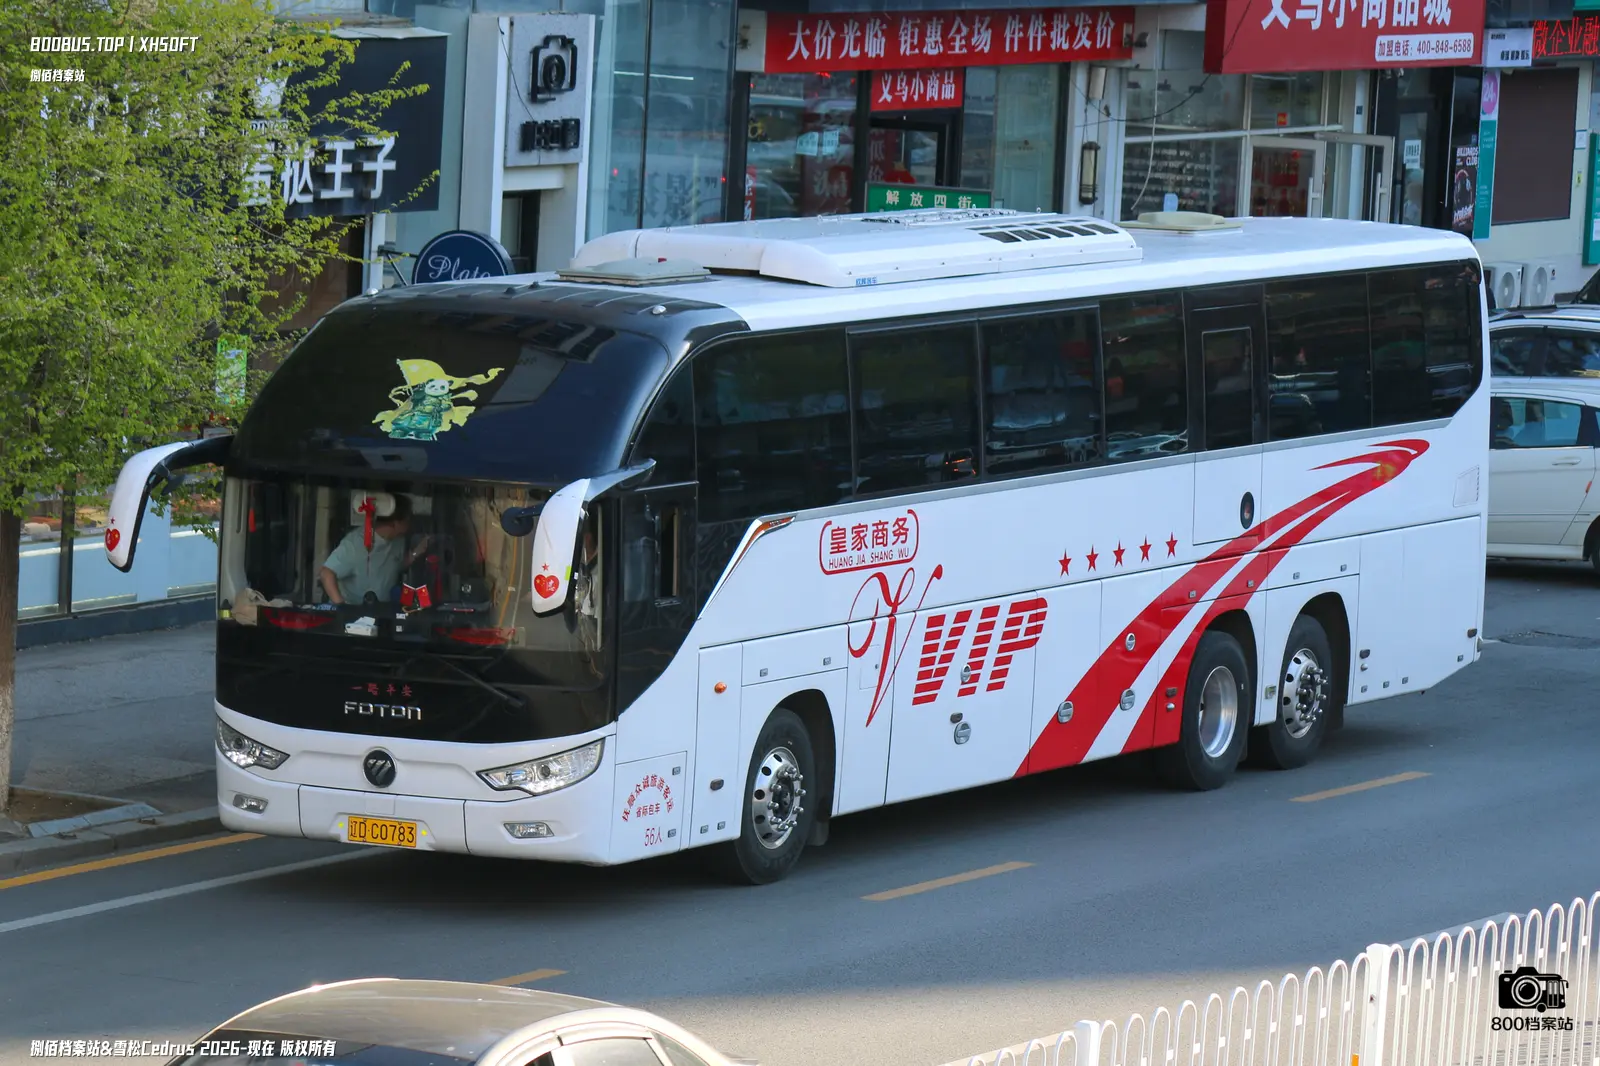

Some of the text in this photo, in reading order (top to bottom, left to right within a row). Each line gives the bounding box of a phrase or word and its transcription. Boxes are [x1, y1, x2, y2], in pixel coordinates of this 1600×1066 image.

[786, 11, 1116, 61] 大价光临 钜惠全场 件件批发价
[878, 70, 955, 104] 义乌小商品
[886, 190, 971, 209] 解放四街
[830, 518, 909, 554] 皇家商务
[828, 547, 910, 569] HUANG JIA SHANG WU
[912, 597, 1048, 706] VIP
[351, 683, 413, 697] 一路平安
[344, 701, 422, 721] FOTON
[644, 826, 663, 847] 56人
